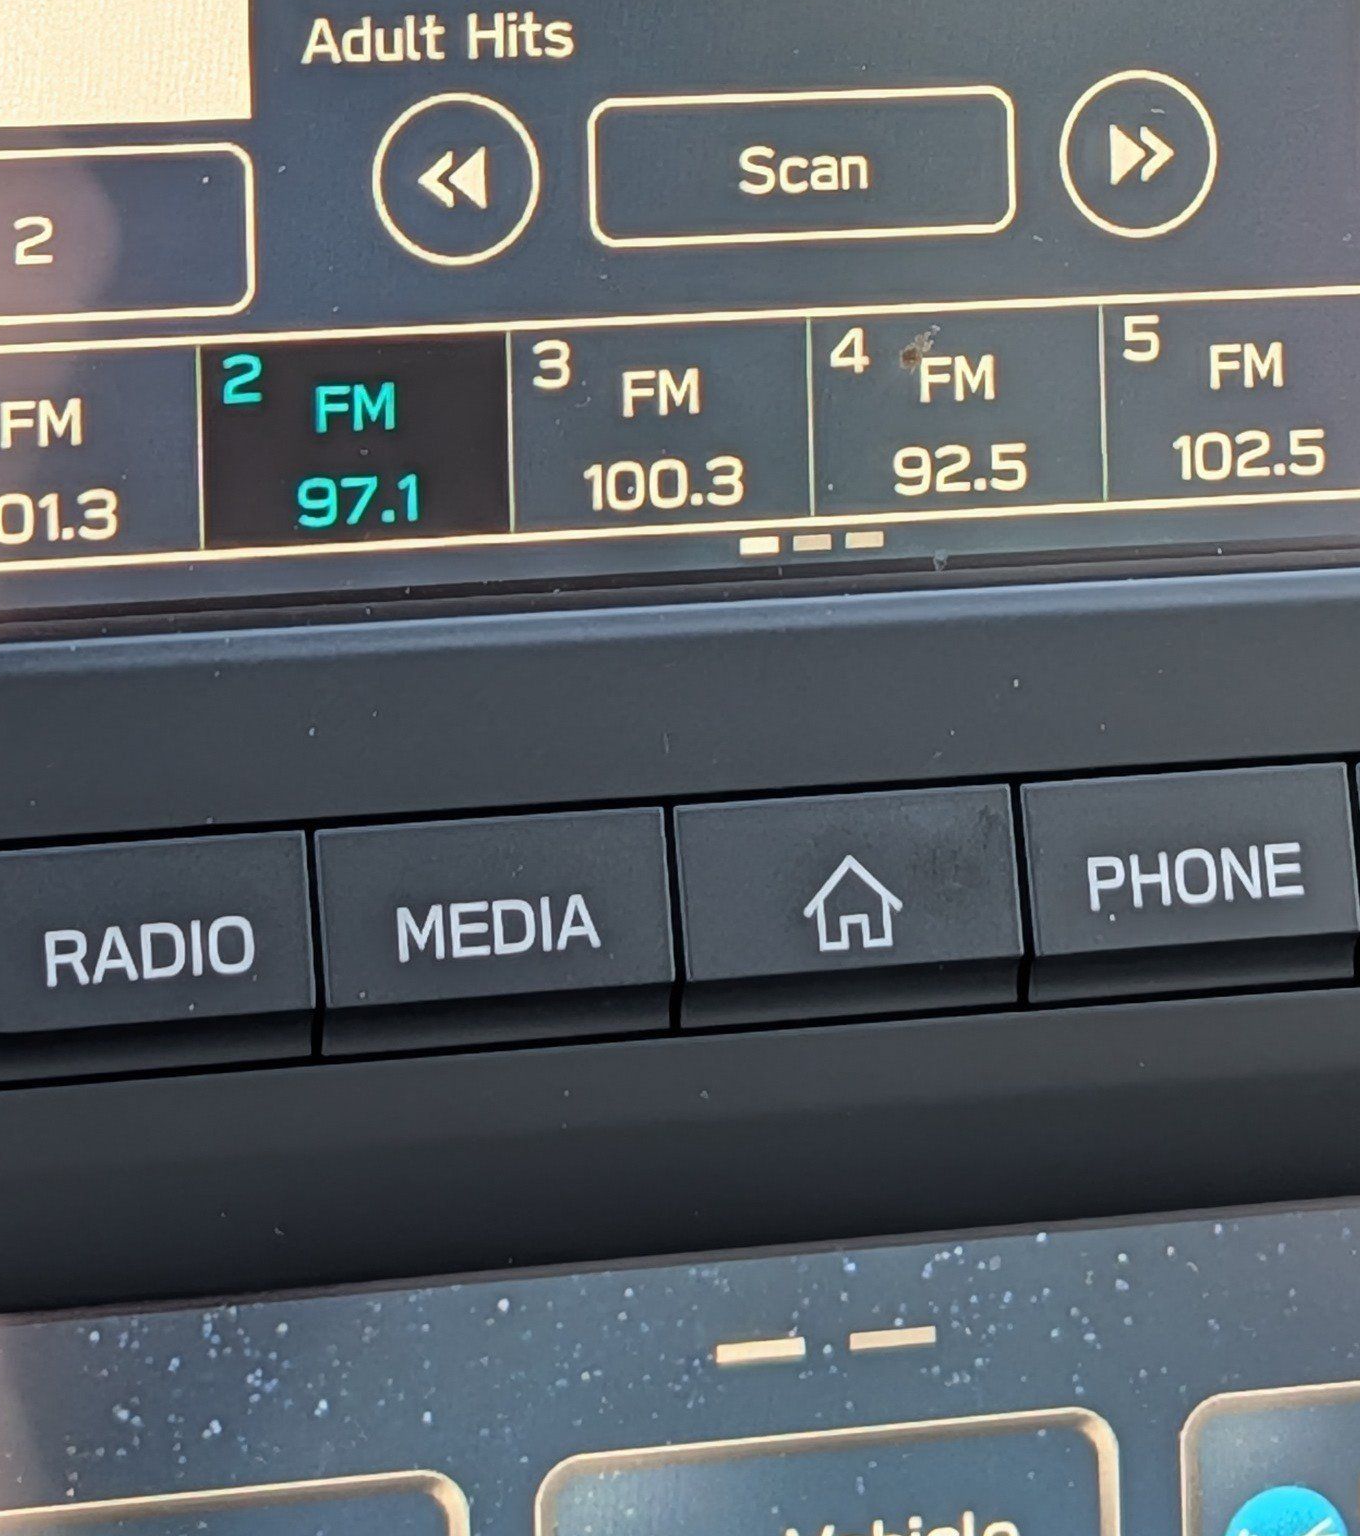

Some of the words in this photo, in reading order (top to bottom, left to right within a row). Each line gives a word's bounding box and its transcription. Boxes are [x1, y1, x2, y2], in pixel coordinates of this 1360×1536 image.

[301, 15, 445, 64] Adult
[468, 12, 574, 59] Hits
[739, 146, 868, 194] Scan
[830, 328, 869, 373] 4
[1123, 315, 1159, 362] 5
[223, 354, 261, 404] 2
[533, 340, 570, 389] 3
[920, 355, 995, 402] FM
[1210, 342, 1283, 389] FM
[315, 382, 395, 432] FM
[623, 368, 699, 417] FM
[0, 398, 82, 448] FM
[893, 443, 1027, 496] 92.5
[1173, 429, 1325, 480] 102.5
[297, 474, 418, 527] 97.1
[584, 456, 744, 511] 100.3
[1088, 843, 1304, 911] PHONE
[45, 916, 254, 987] RADIO
[397, 894, 601, 962] MEDIA
